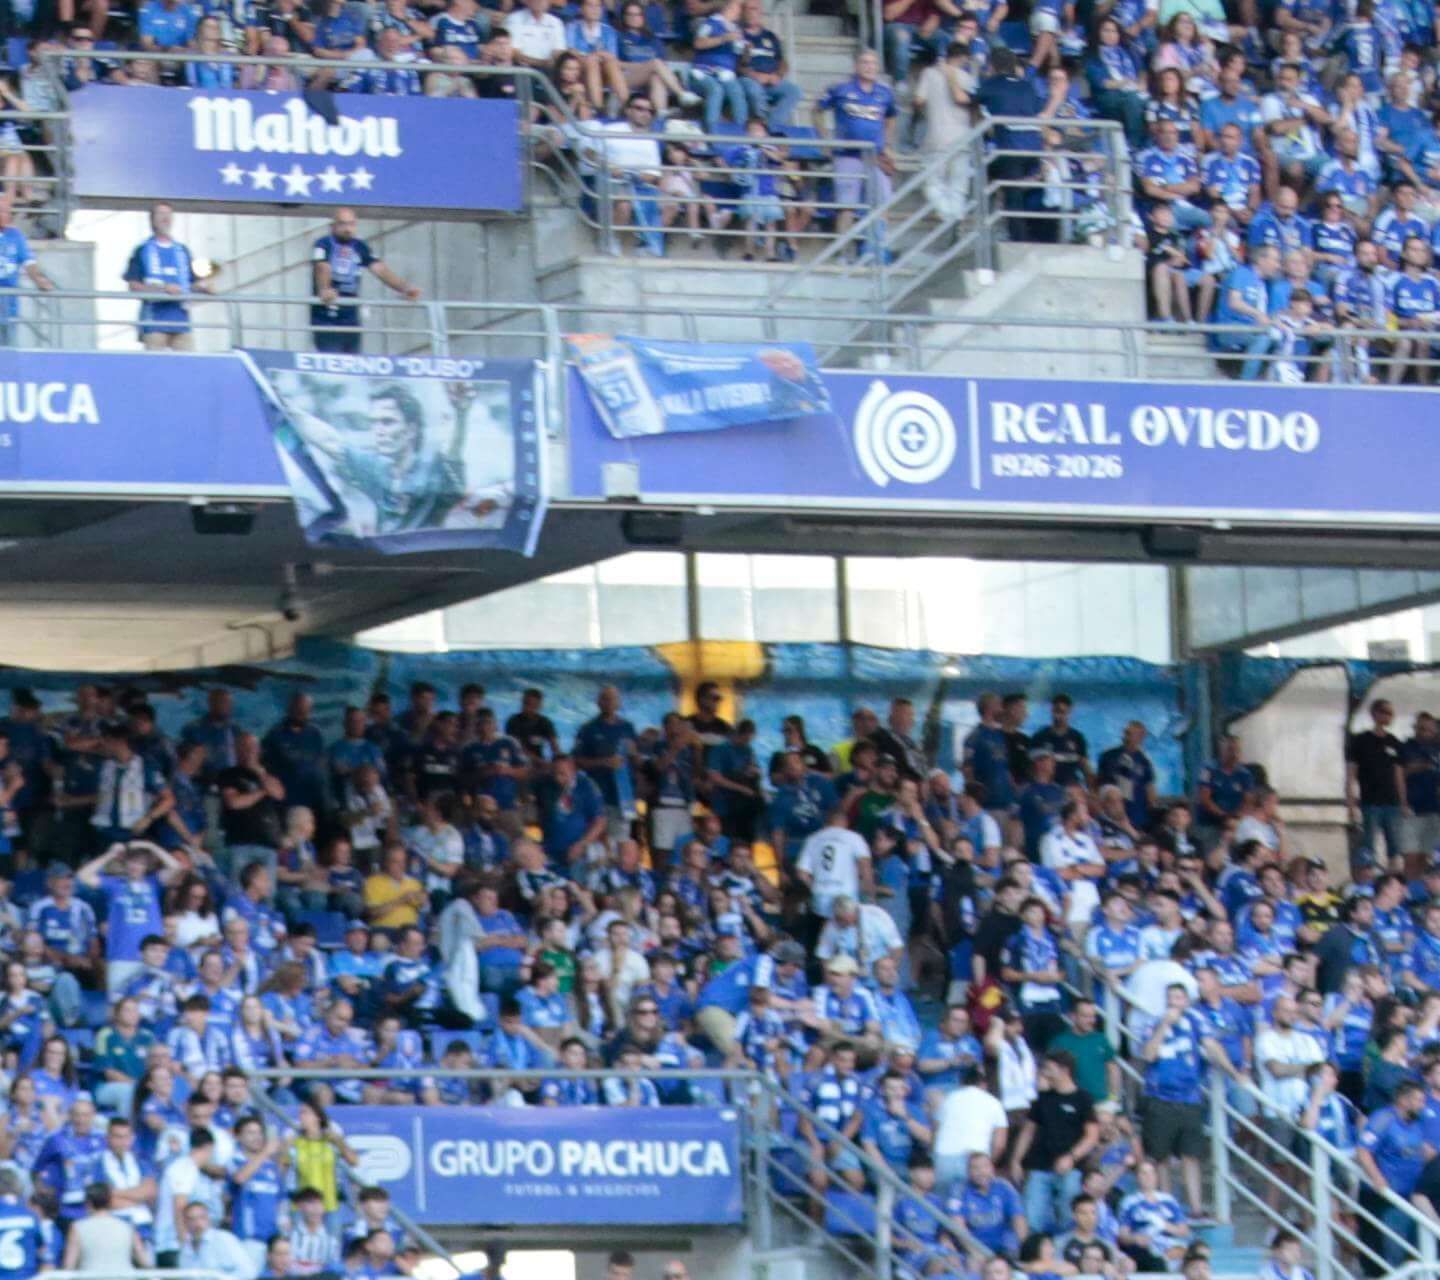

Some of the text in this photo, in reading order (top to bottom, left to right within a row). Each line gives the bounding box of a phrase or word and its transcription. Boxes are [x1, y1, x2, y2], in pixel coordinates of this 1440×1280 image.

[187, 96, 403, 158] Mahou
[294, 352, 394, 376] ETERNO
[990, 401, 1321, 453] REAL OVIEDO
[429, 1138, 732, 1177] GRUPO PACHUCA
